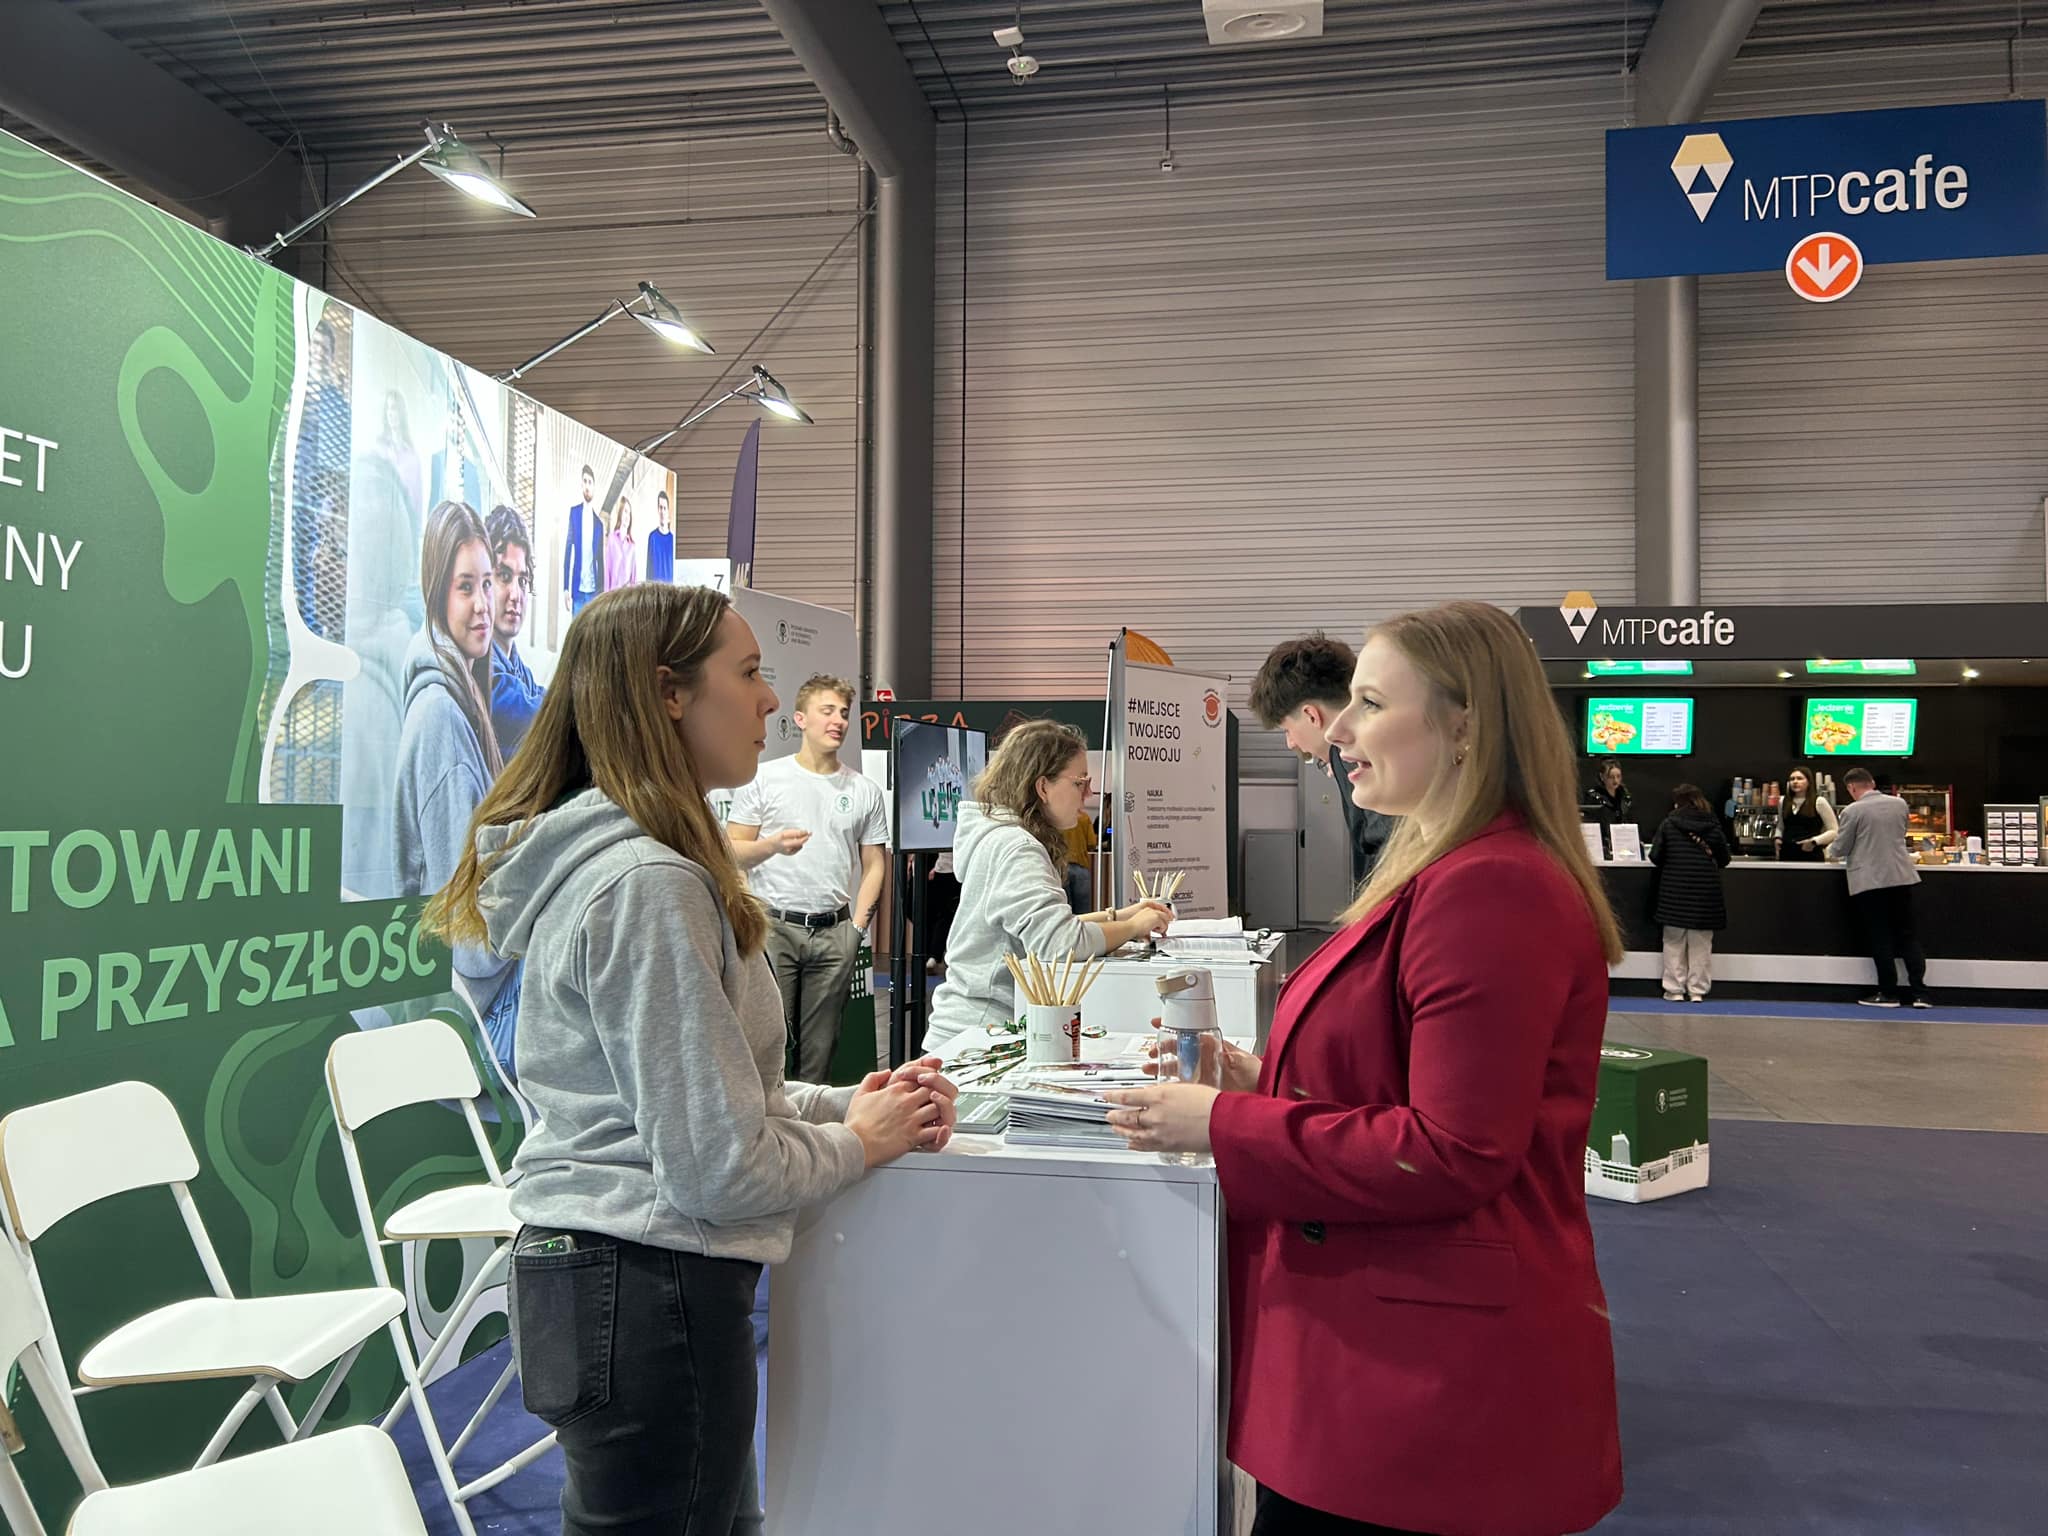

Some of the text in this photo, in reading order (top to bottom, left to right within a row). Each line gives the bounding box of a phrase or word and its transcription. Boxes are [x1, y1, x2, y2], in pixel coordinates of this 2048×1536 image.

[1744, 154, 1968, 221] MTPcafe
[0, 524, 83, 590] NY
[1603, 610, 1735, 645] MTPcafe
[1128, 698, 1180, 717] #MIEJSCE
[1128, 722, 1180, 740] TWOJEGO
[1128, 745, 1181, 762] ROZWOJU
